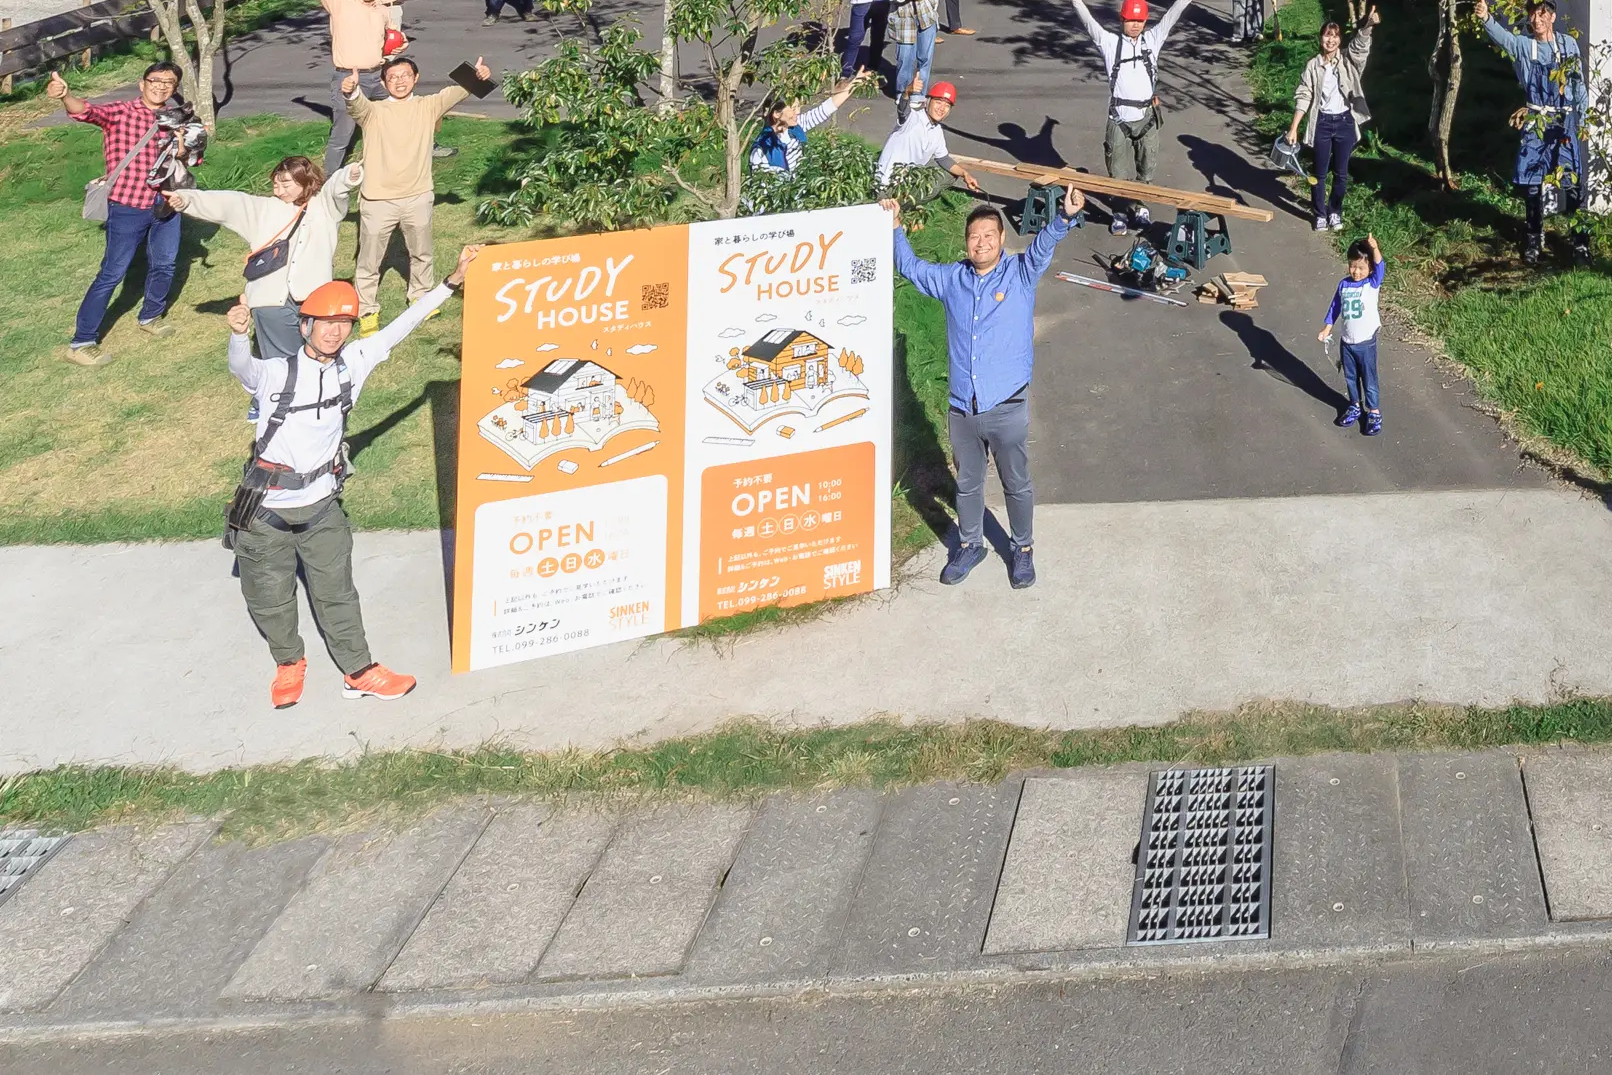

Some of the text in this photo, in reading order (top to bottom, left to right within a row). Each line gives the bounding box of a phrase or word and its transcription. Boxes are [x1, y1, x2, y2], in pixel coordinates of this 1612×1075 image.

[714, 229, 796, 246] 家と暮らしの学び場
[491, 252, 581, 272] 家と暮らしの学び場
[718, 230, 844, 294] STUDY
[495, 254, 635, 323] STUDY
[757, 274, 840, 301] HOUSE
[537, 300, 630, 330] HOUSE
[732, 472, 774, 489] 予約不要
[817, 478, 843, 490] 10:00
[731, 483, 811, 517] OPEN
[817, 491, 843, 503] 16:00
[509, 520, 595, 555] OPEN
[823, 559, 862, 579] SINKEN
[823, 572, 861, 590] STYLE
[609, 600, 650, 619] SINKEN
[608, 613, 649, 631] STYLE
[492, 628, 591, 655] TEL.099-286-0088
